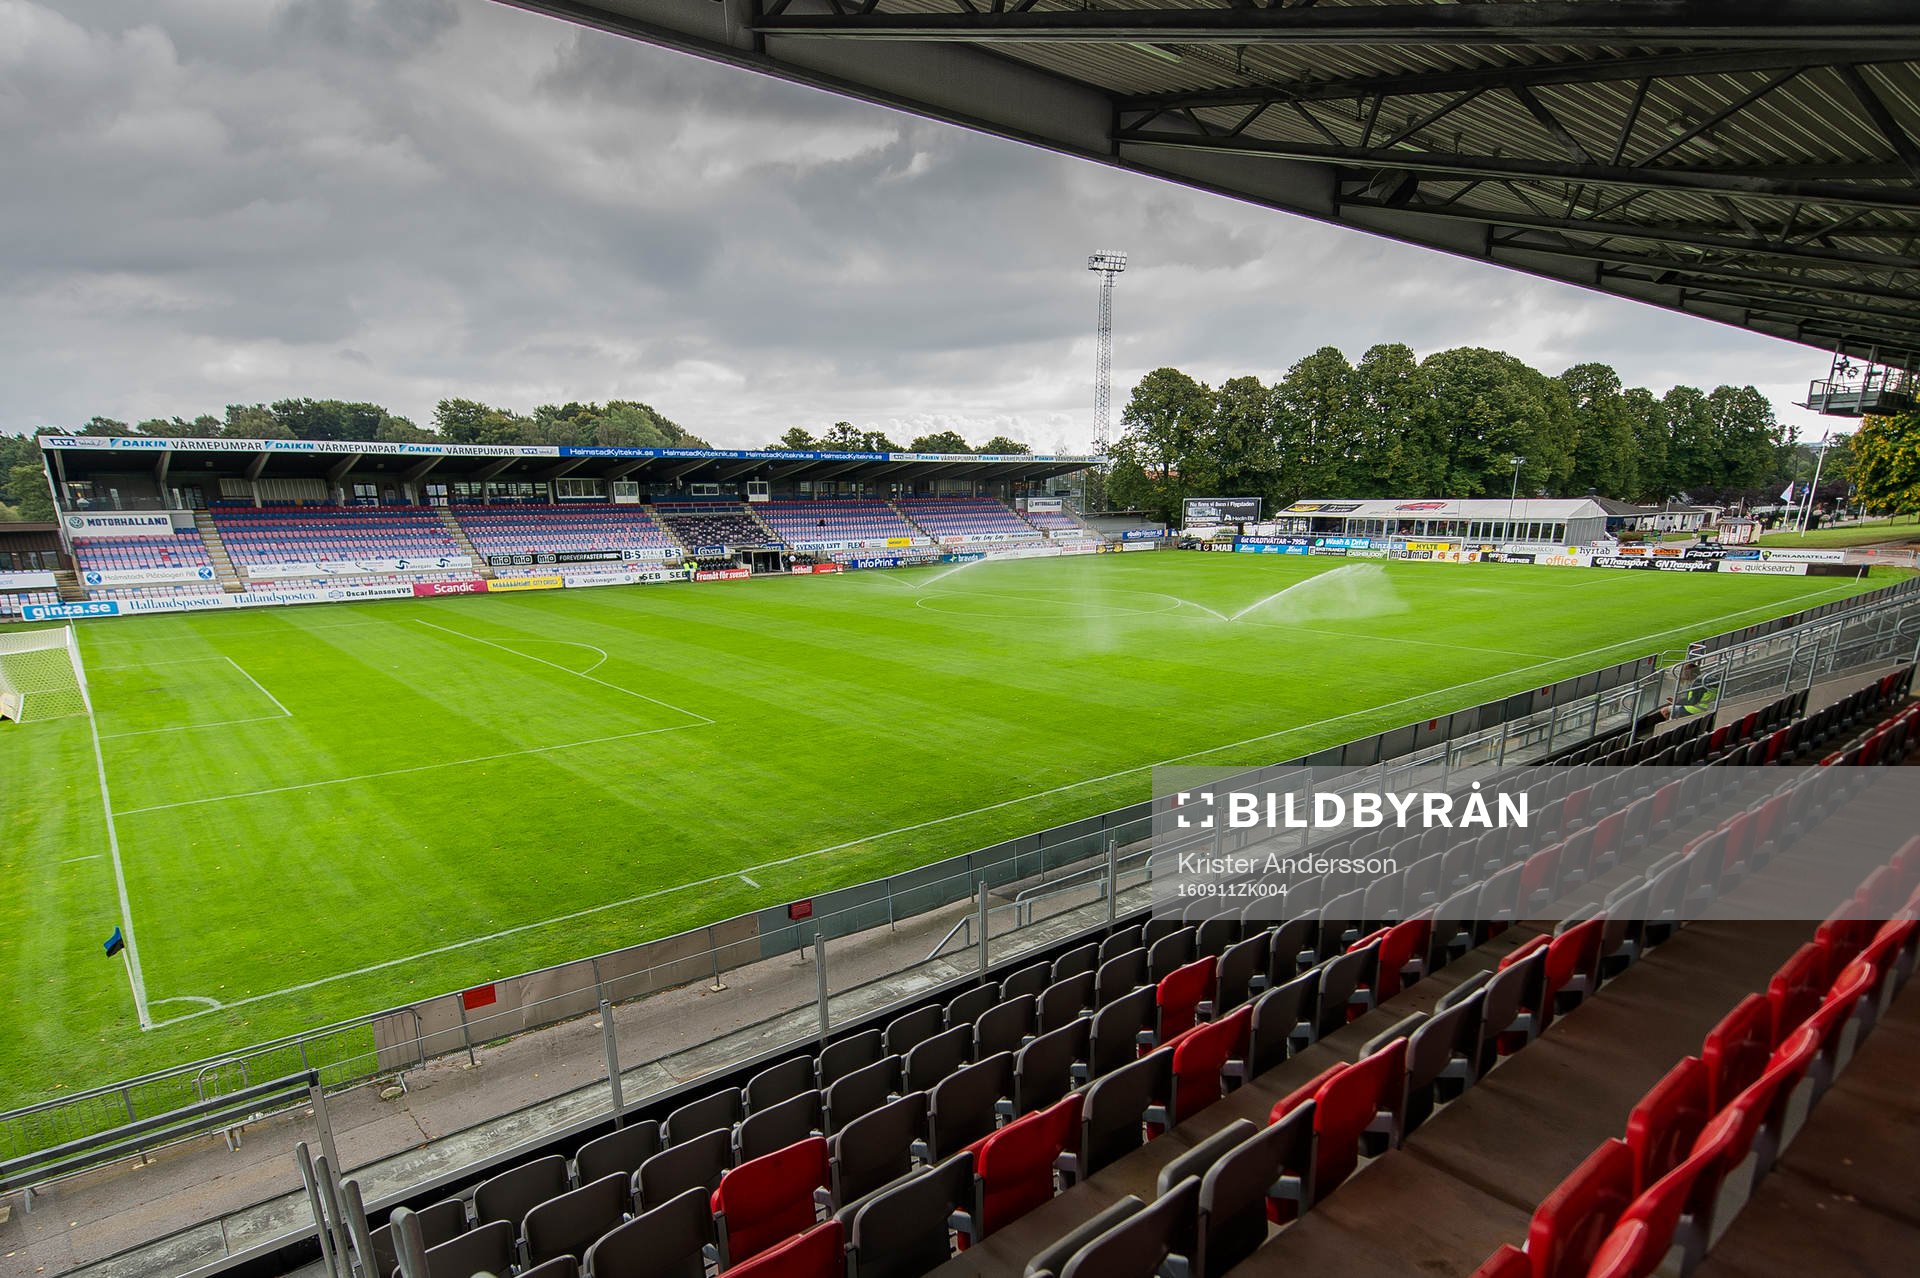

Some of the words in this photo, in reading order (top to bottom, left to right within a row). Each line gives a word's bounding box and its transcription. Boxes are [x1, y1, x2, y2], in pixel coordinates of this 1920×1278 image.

[171, 440, 263, 450] VÄRMEPUMPAR
[318, 443, 397, 454] VÄRMEPUMPAR
[446, 446, 515, 456] VÄRMEPUMPAR
[569, 448, 654, 457] HalmstadKylteknik.se
[662, 449, 738, 458] HalmstadKylteknik.se
[87, 517, 168, 527] MOTORHALLAND
[1351, 539, 1369, 547] Drive
[1580, 547, 1611, 557] hyrtab
[1546, 555, 1578, 566] office
[1745, 562, 1795, 573] quicksearch
[642, 572, 660, 580] SEB
[434, 580, 475, 593] Scandic
[32, 603, 111, 619] ginza.se
